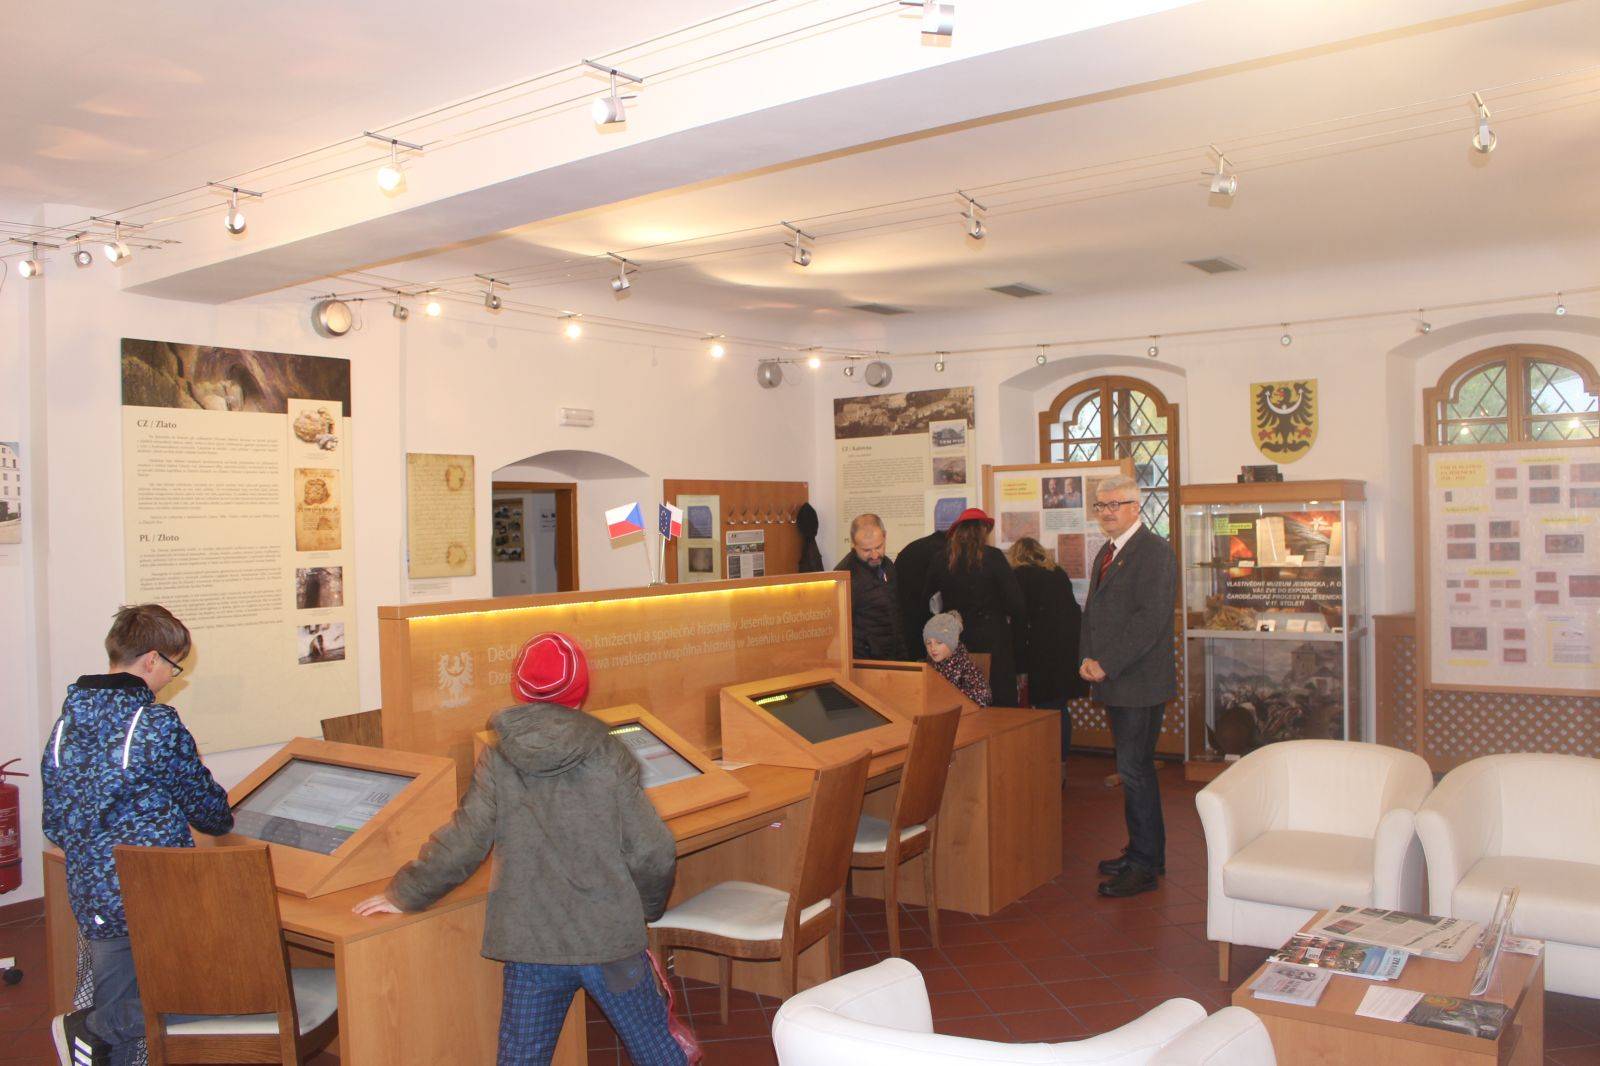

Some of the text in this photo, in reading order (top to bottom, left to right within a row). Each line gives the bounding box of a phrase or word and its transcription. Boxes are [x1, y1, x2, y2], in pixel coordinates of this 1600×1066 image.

[137, 419, 148, 428] CZ
[155, 419, 177, 429] Zlato
[139, 534, 150, 542] PL
